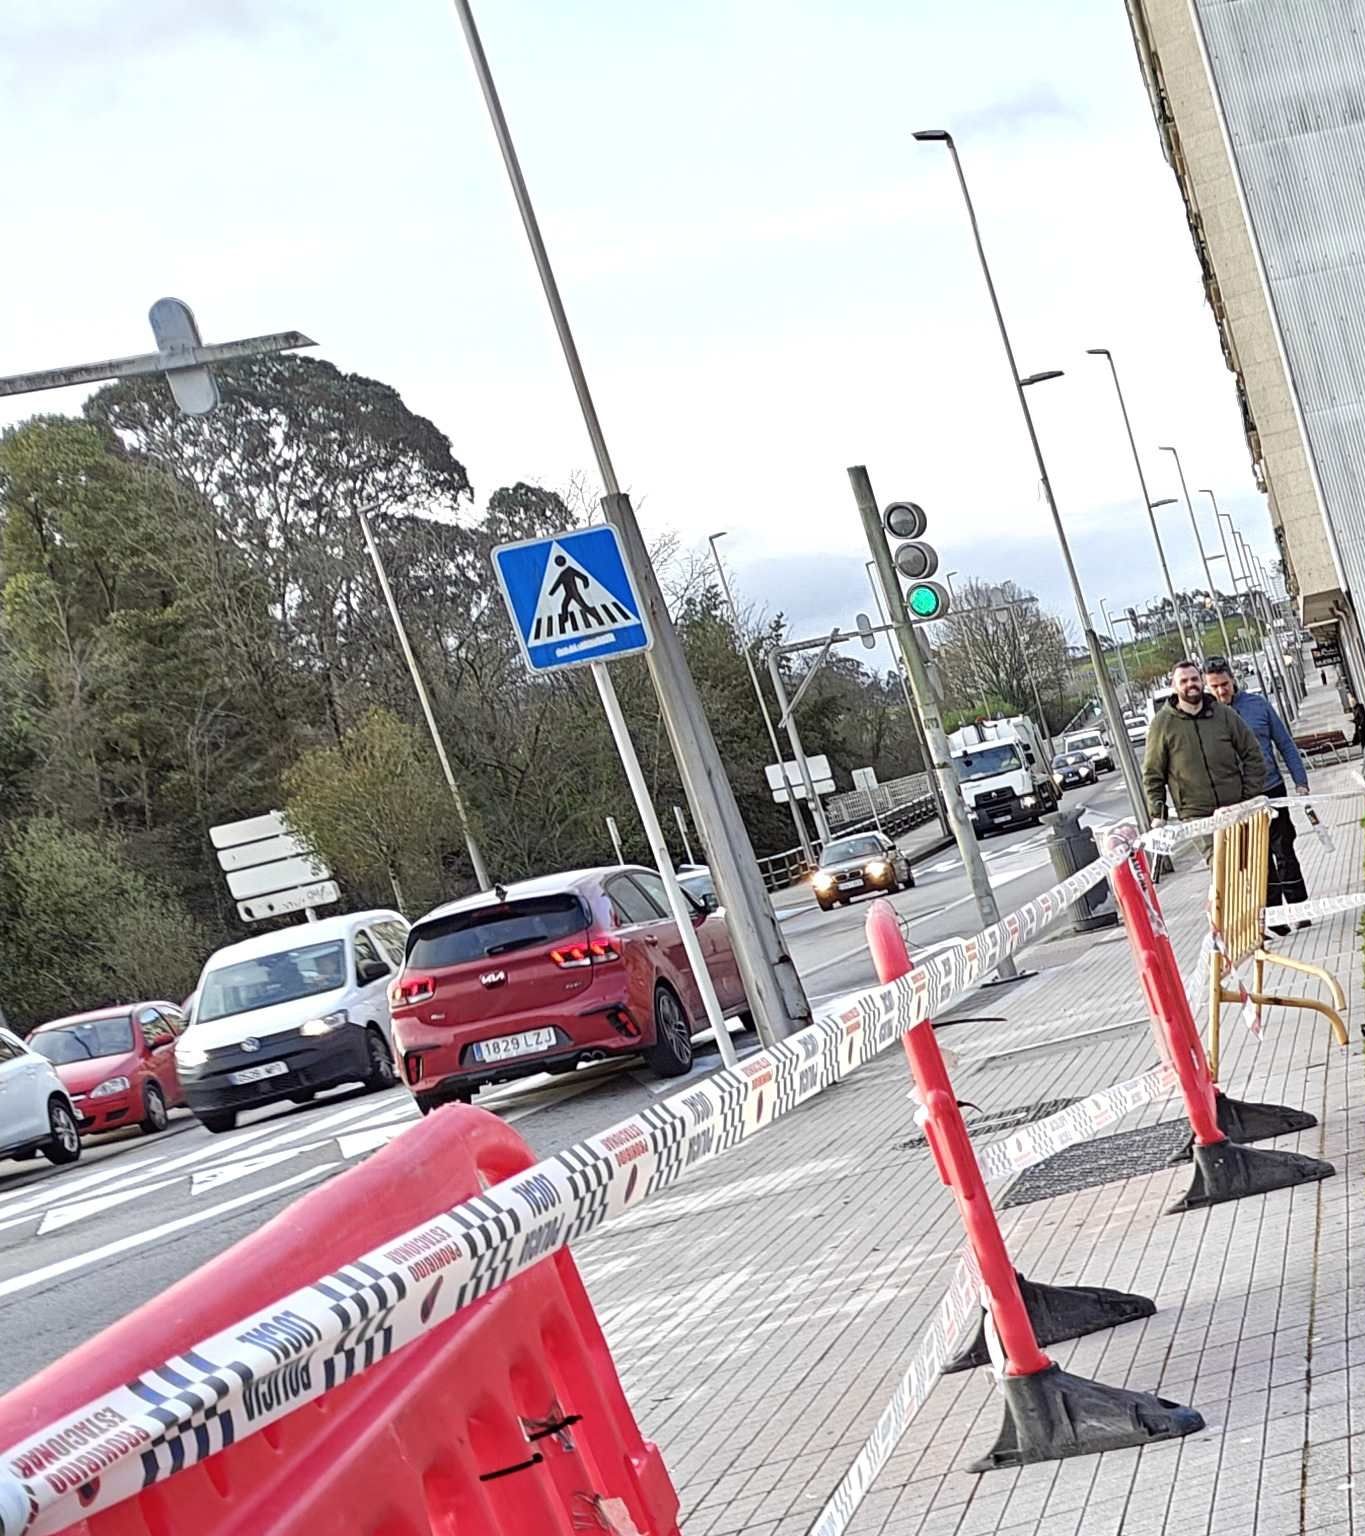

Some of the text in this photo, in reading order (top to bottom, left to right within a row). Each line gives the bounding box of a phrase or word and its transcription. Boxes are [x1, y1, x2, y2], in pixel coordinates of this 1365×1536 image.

[485, 1029, 552, 1056] 1829 LZJ
[512, 1174, 561, 1218] LOCAL
[384, 1226, 453, 1265] ESTACIONAR
[408, 1241, 463, 1282] PROHIBIDO
[236, 1310, 322, 1364] LOCAL
[11, 1406, 128, 1479] ESTACIONAR
[45, 1424, 151, 1494] PROHIBIDO
